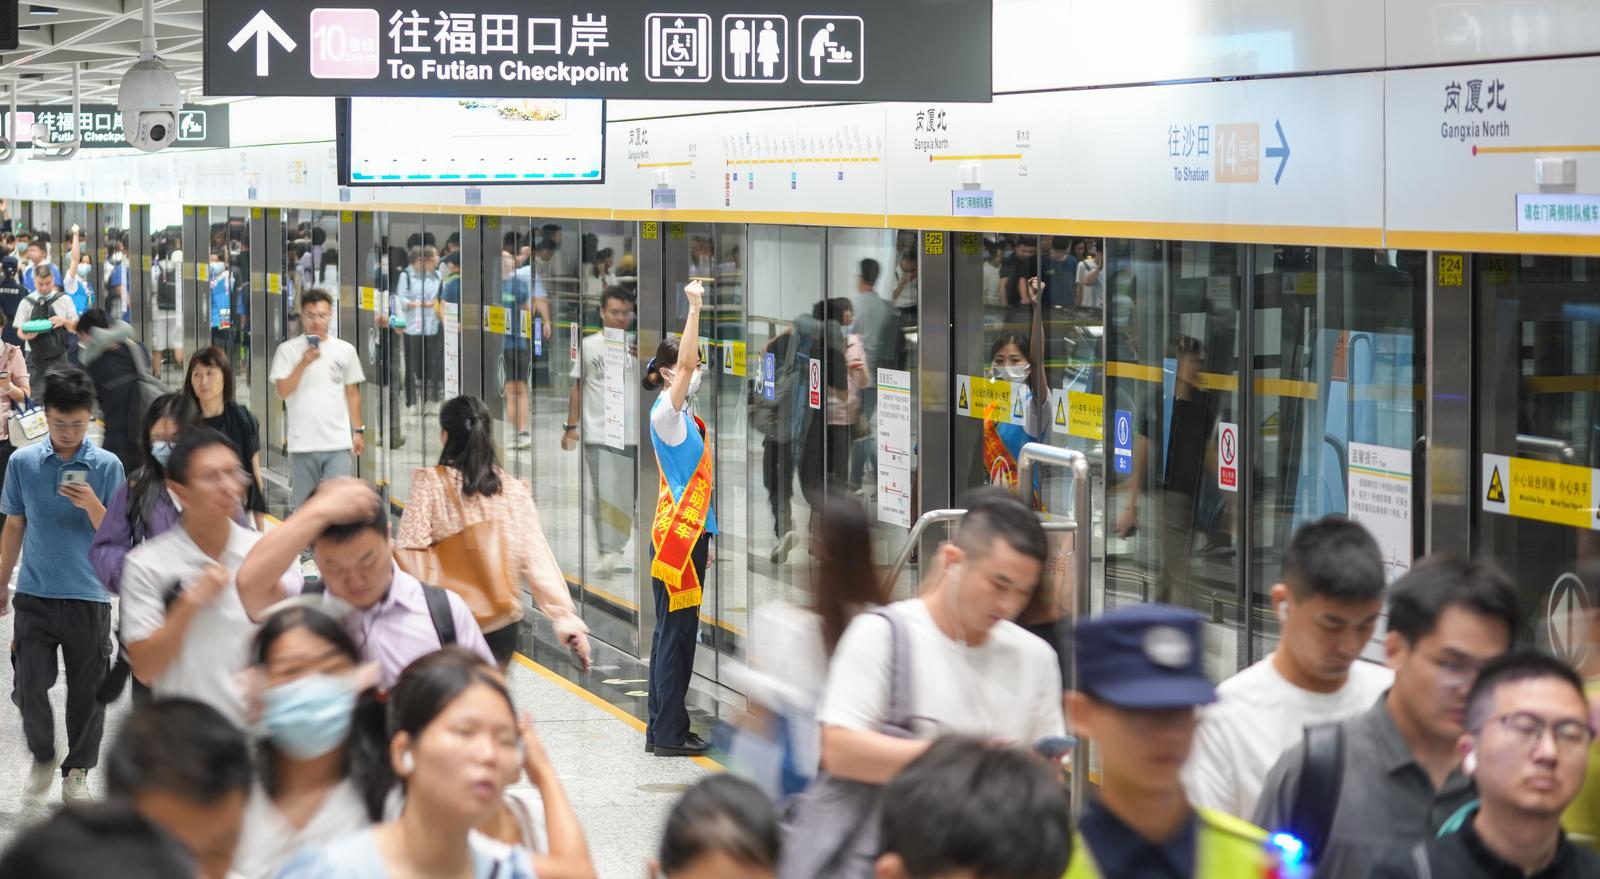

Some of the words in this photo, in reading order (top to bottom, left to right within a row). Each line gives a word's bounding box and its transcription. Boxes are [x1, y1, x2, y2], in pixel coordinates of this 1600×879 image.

[314, 25, 346, 62] 10
[388, 9, 610, 56] 往福田口岸
[387, 59, 415, 80] To
[422, 60, 493, 81] Futian
[499, 60, 629, 86] Checkpoint
[1444, 78, 1507, 113] 岗厦北
[916, 108, 947, 132] 岗厦北
[1441, 121, 1480, 142] Gangxia
[1482, 120, 1510, 137] North
[84, 131, 126, 143] Checkpo
[935, 138, 948, 149] North
[1168, 124, 1209, 157] 往沙田
[1217, 129, 1237, 175] 14
[1173, 166, 1182, 181] To
[1183, 166, 1209, 181] Shatian
[1524, 203, 1599, 222] 请在门两侧排队候车
[647, 223, 657, 231] 26
[930, 234, 942, 245] 25
[1446, 258, 1460, 272] 24
[1513, 472, 1555, 491] 小心站台间隙
[1559, 477, 1588, 496] 小心夹手
[674, 478, 709, 539] 文明乘车
